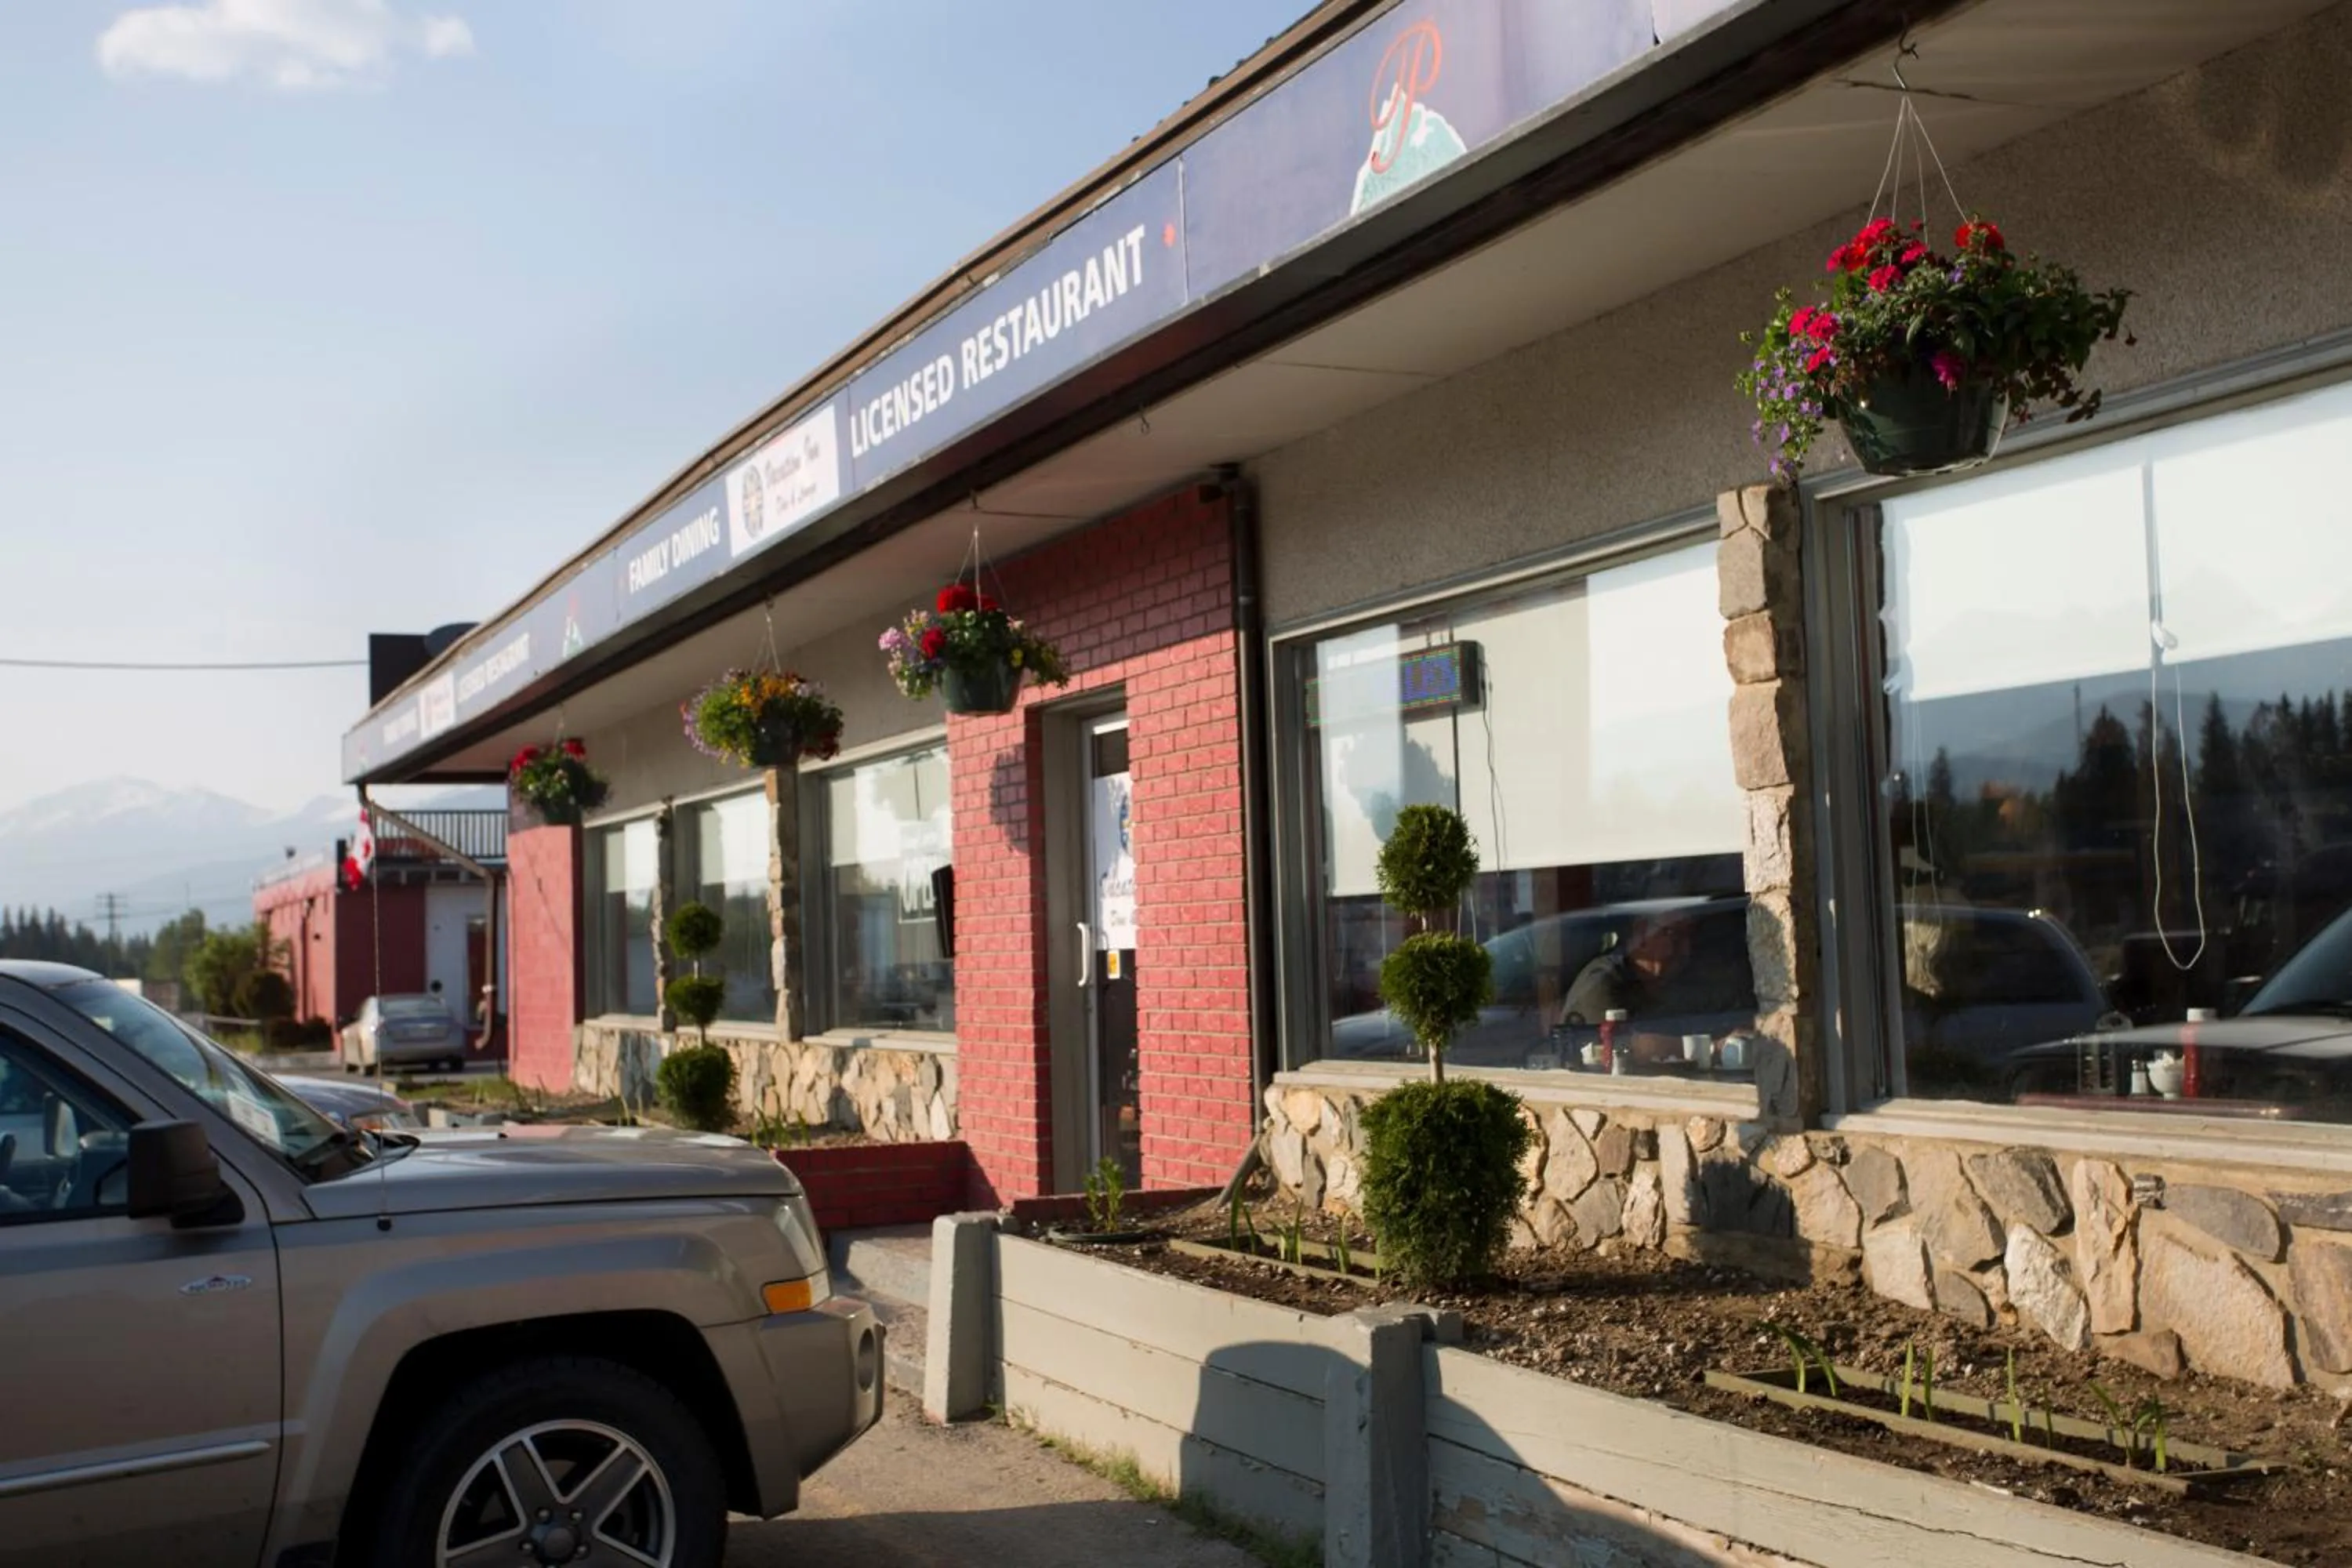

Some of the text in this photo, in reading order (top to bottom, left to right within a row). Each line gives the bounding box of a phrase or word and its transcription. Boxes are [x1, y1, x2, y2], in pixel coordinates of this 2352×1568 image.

[850, 223, 1145, 459] LICENSED RESTAURANT
[628, 505, 720, 594] FAMILY DINING
